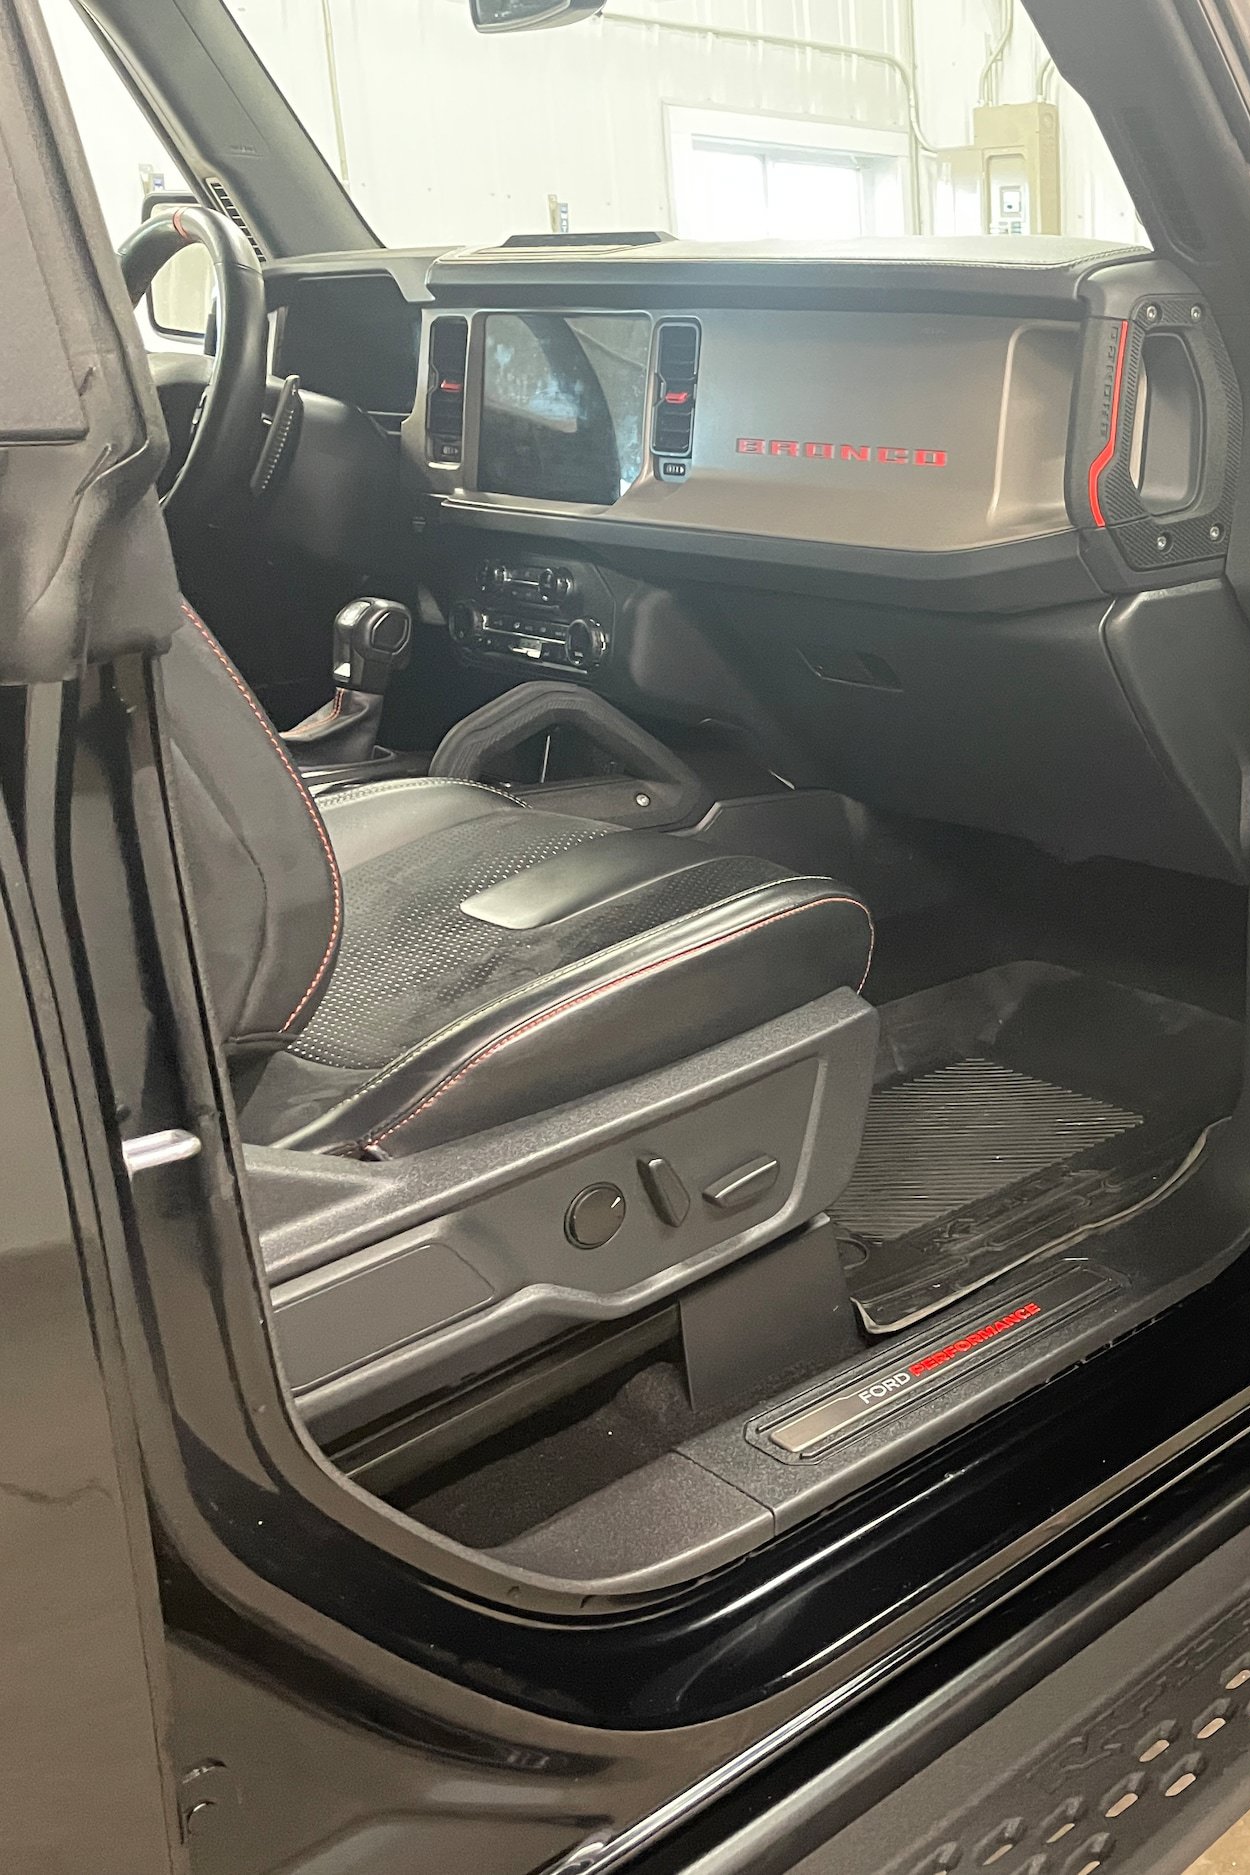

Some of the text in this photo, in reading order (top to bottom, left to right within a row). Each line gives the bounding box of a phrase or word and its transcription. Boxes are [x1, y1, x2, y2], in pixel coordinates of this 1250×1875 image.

[736, 438, 948, 467] BRONCO
[858, 1302, 1041, 1405] FORD PERFORMANCE
